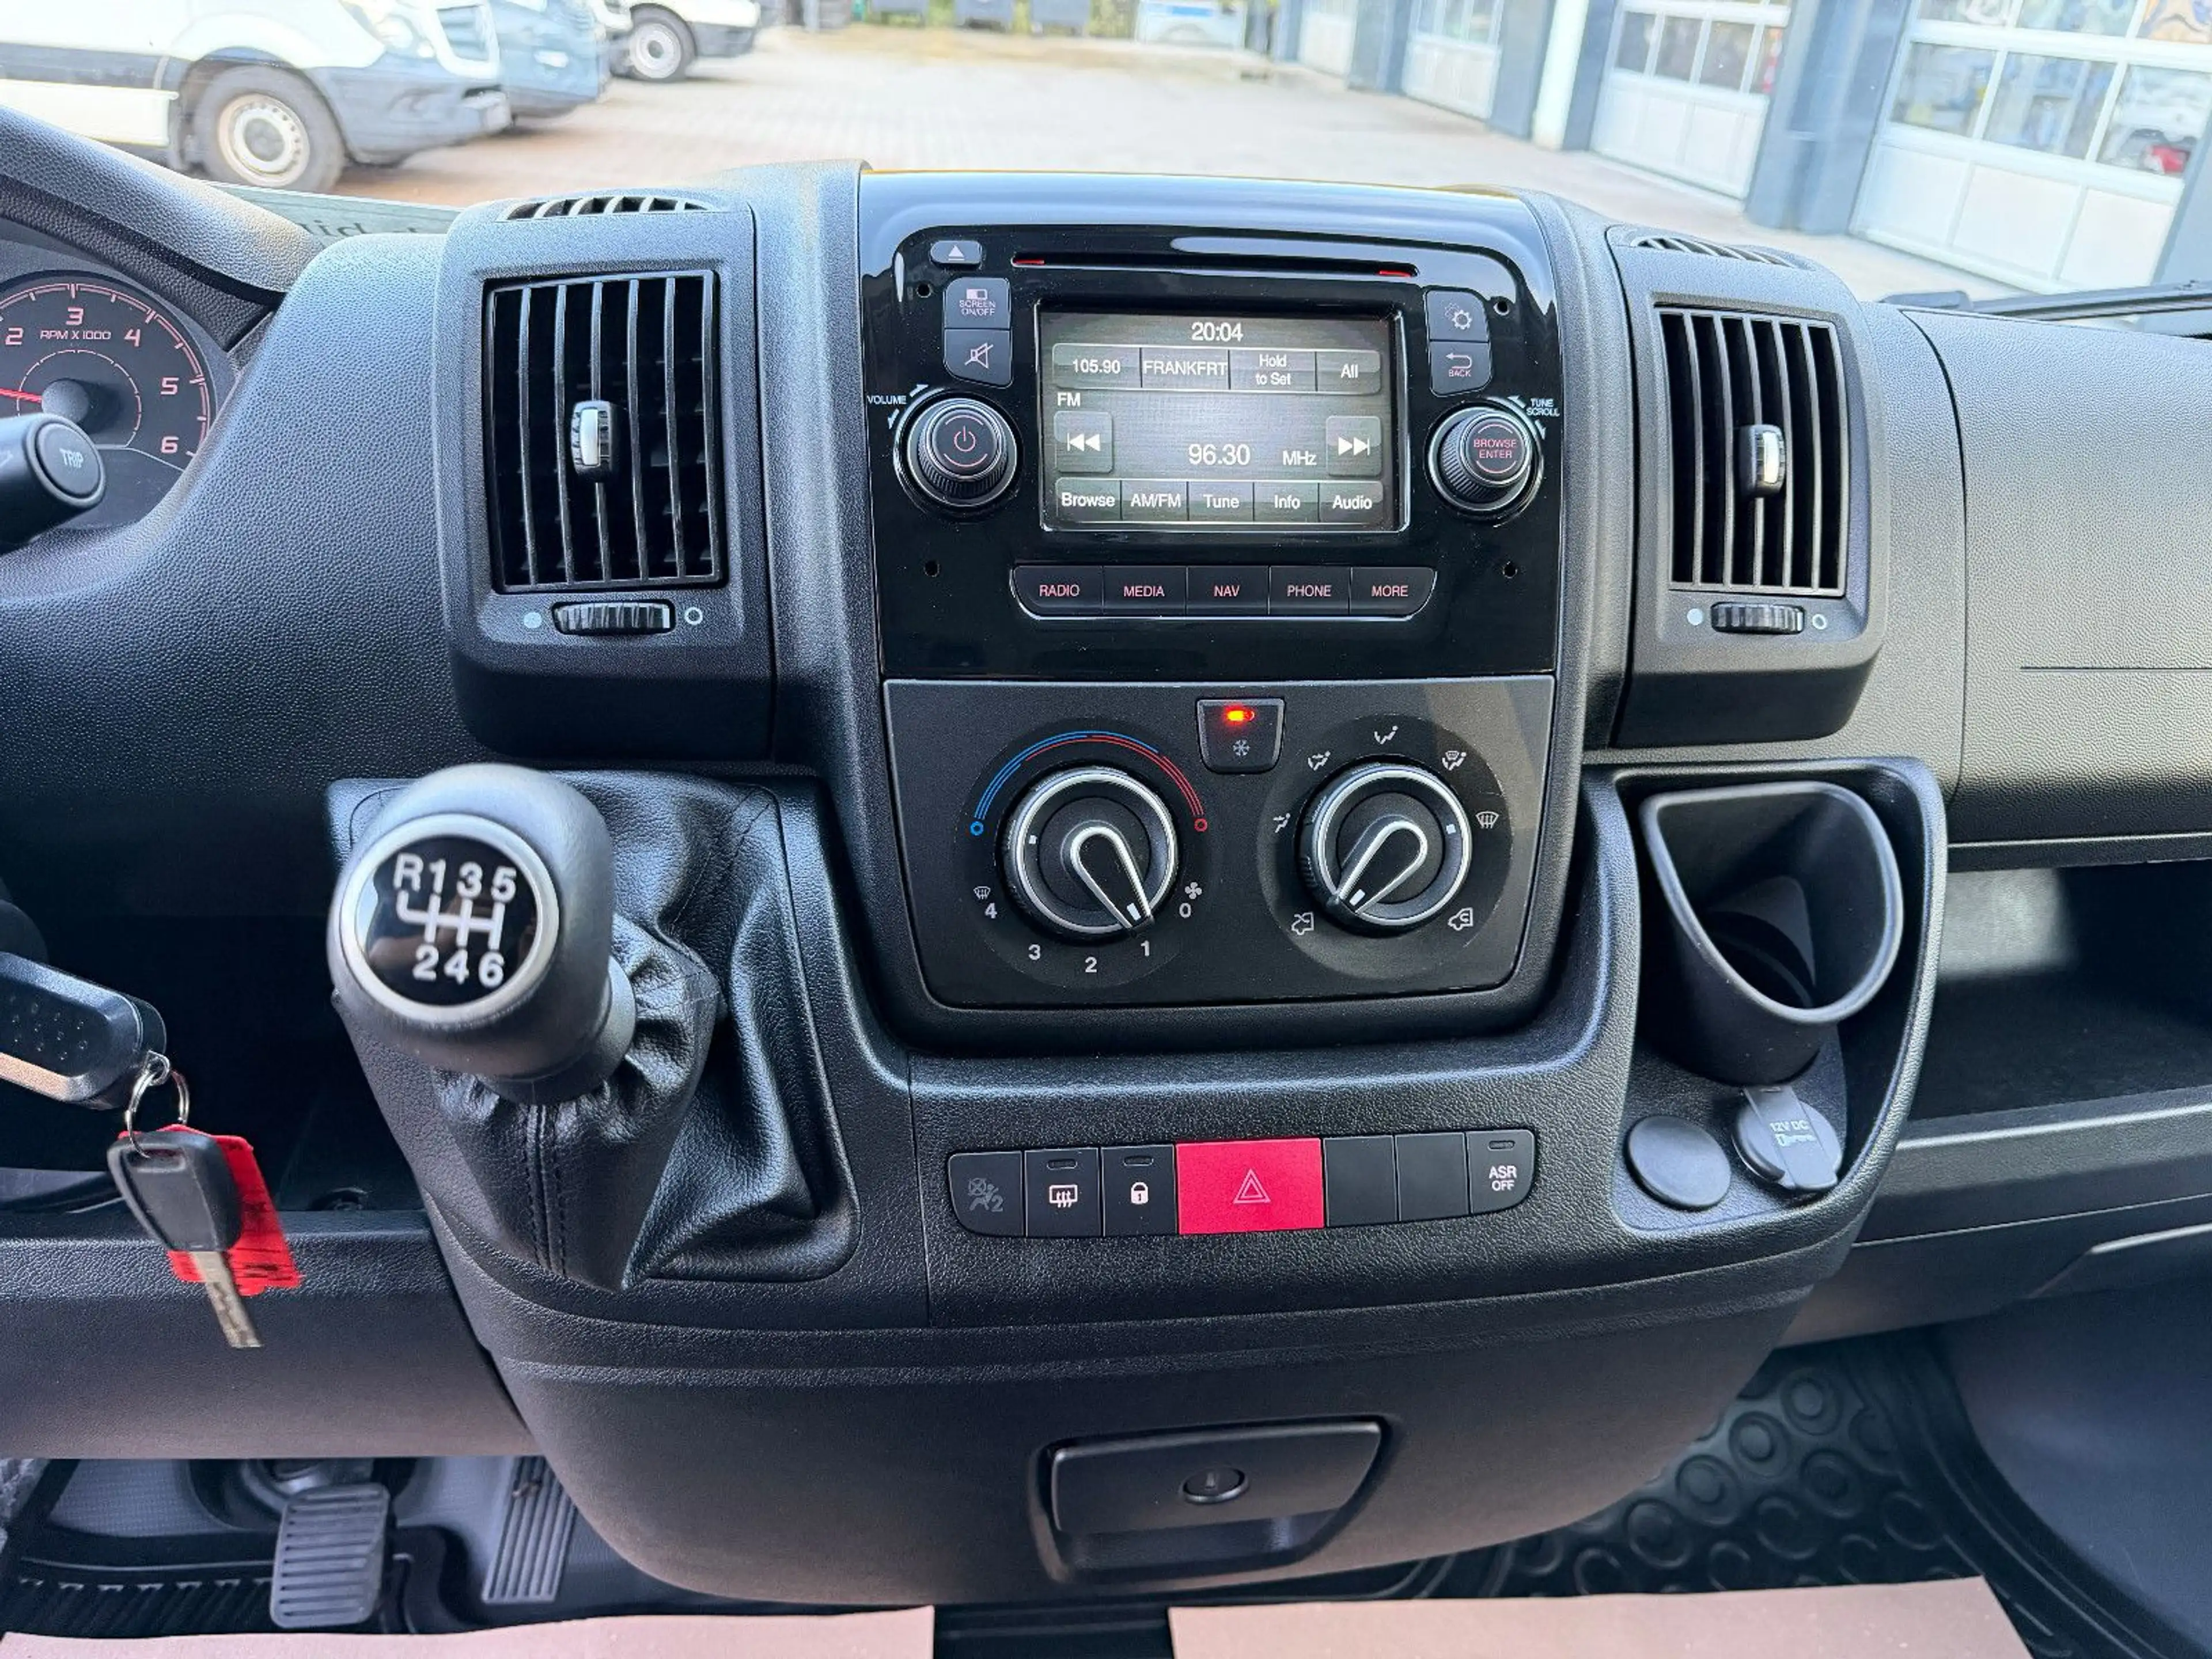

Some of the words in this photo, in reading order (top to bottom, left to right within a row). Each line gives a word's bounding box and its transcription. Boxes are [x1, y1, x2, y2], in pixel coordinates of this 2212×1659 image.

[959, 300, 996, 308] SCREEN
[66, 307, 84, 325] 3
[961, 307, 995, 316] ON/OFF
[5, 328, 24, 345] 2
[40, 331, 68, 340] RPM
[71, 331, 81, 339] X
[82, 331, 112, 340] 1000
[124, 329, 141, 347] 4
[1192, 323, 1243, 342] 20:04
[1072, 359, 1121, 373] 105.90
[1143, 361, 1228, 375] FRANKFRT
[1259, 354, 1286, 368] Hold
[1340, 364, 1358, 378] All
[1448, 369, 1471, 377] BACK
[1256, 373, 1268, 385] to
[1271, 373, 1291, 385] Set
[160, 378, 179, 395] 5
[866, 395, 907, 404] VOLUME
[1058, 393, 1080, 406] FM
[1530, 399, 1554, 407] TUNE
[1526, 407, 1559, 416] SCROLL
[161, 436, 179, 453] 6
[1473, 439, 1517, 449] BROWSE
[59, 448, 84, 468] TRIP
[1188, 444, 1249, 465] 96.30
[1282, 451, 1316, 466] MHz
[1479, 449, 1512, 460] ENTER
[1061, 492, 1115, 507] Browse
[1131, 494, 1181, 507] AM/FM
[1203, 494, 1240, 508] Tune
[1274, 495, 1300, 509] Info
[1332, 495, 1372, 510] Audio
[1039, 585, 1080, 597] RADIO
[1123, 585, 1165, 597] MEDIA
[1214, 585, 1240, 597] NAV
[1287, 585, 1332, 597] PHONE
[1372, 585, 1408, 597] MORE
[393, 853, 424, 892] R
[429, 859, 446, 894] 1
[457, 862, 483, 899] 3
[491, 868, 517, 903] 5
[984, 903, 997, 918] 4
[1180, 903, 1191, 918] 0
[1028, 945, 1040, 960] 3
[1141, 941, 1150, 956] 1
[413, 944, 439, 982] 2
[444, 950, 469, 984] 4
[479, 952, 504, 988] 6
[1085, 957, 1097, 972] 2
[1489, 1166, 1517, 1178] ASR
[1491, 1179, 1515, 1191] OFF
